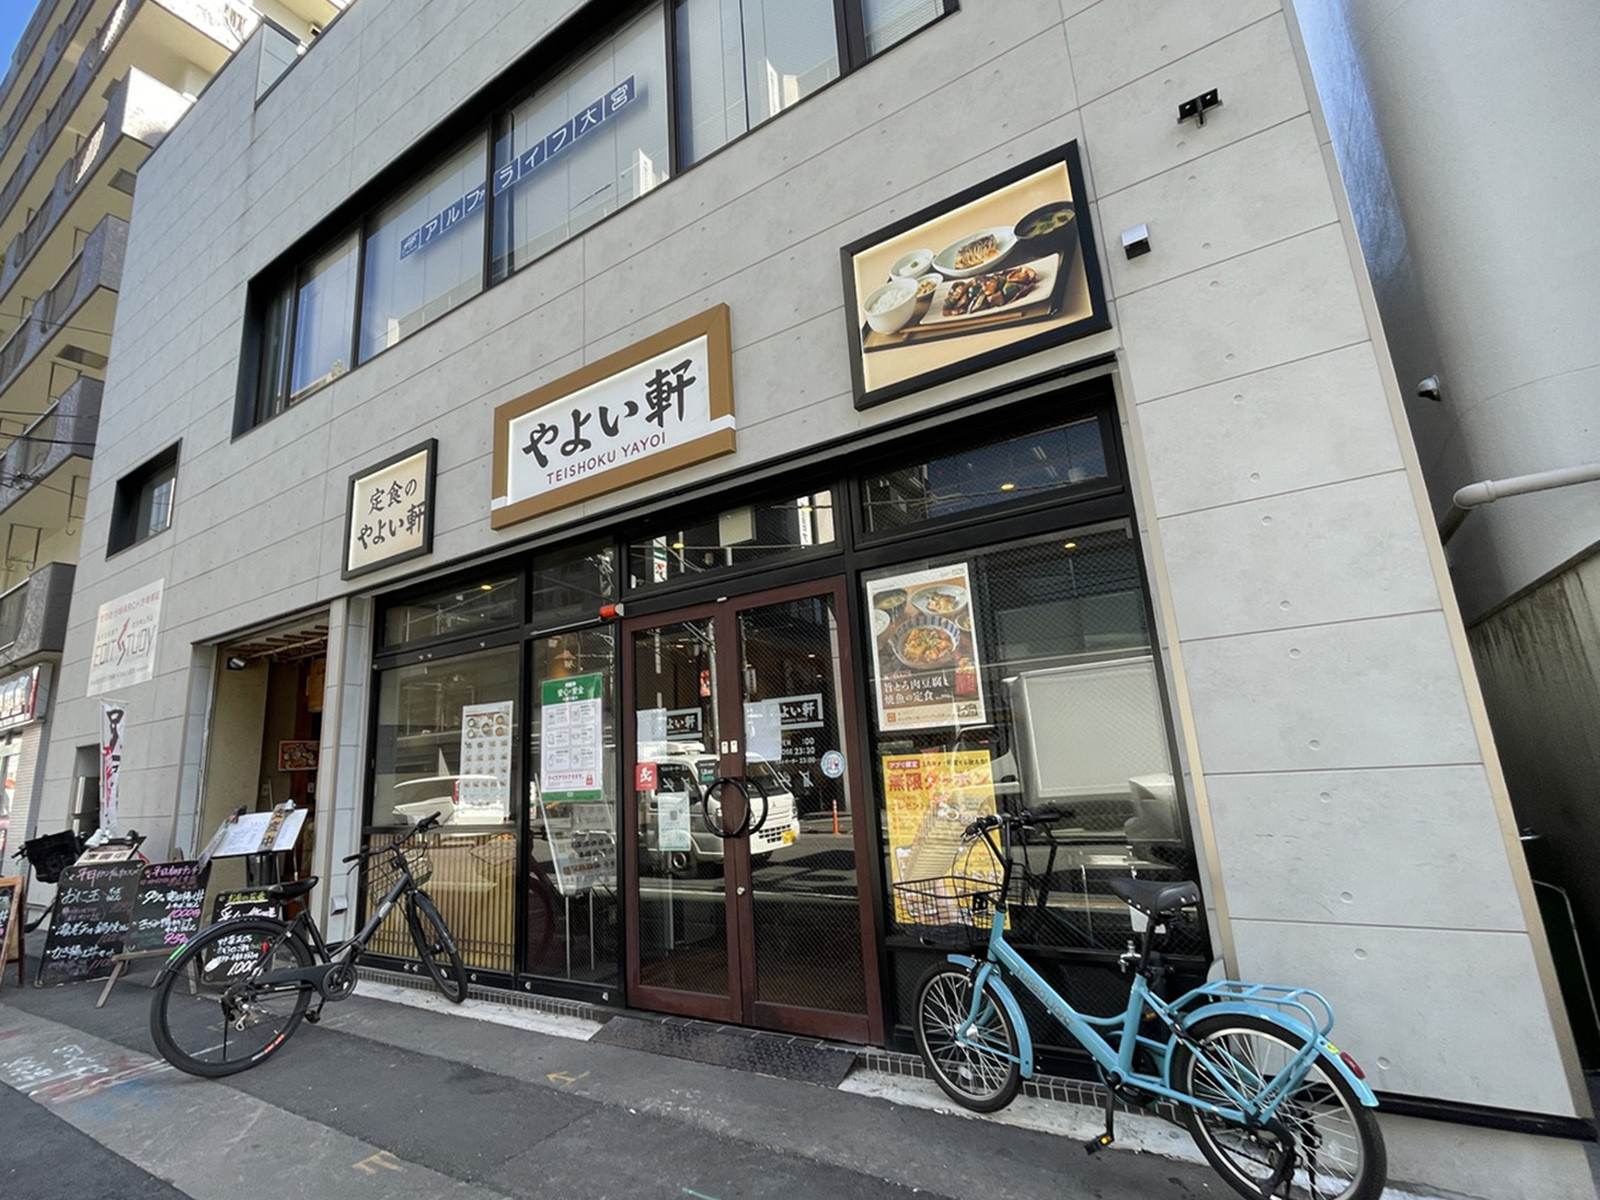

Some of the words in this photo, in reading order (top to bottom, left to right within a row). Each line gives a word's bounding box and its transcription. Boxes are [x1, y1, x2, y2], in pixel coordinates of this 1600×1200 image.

[522, 358, 696, 469] やよい軒
[546, 450, 616, 485] TEISHOKU
[621, 431, 666, 458] YAYOI
[368, 478, 417, 515] 定食の
[357, 500, 425, 550] やよい軒
[667, 715, 696, 730] よい軒
[780, 702, 815, 718] よい軒
